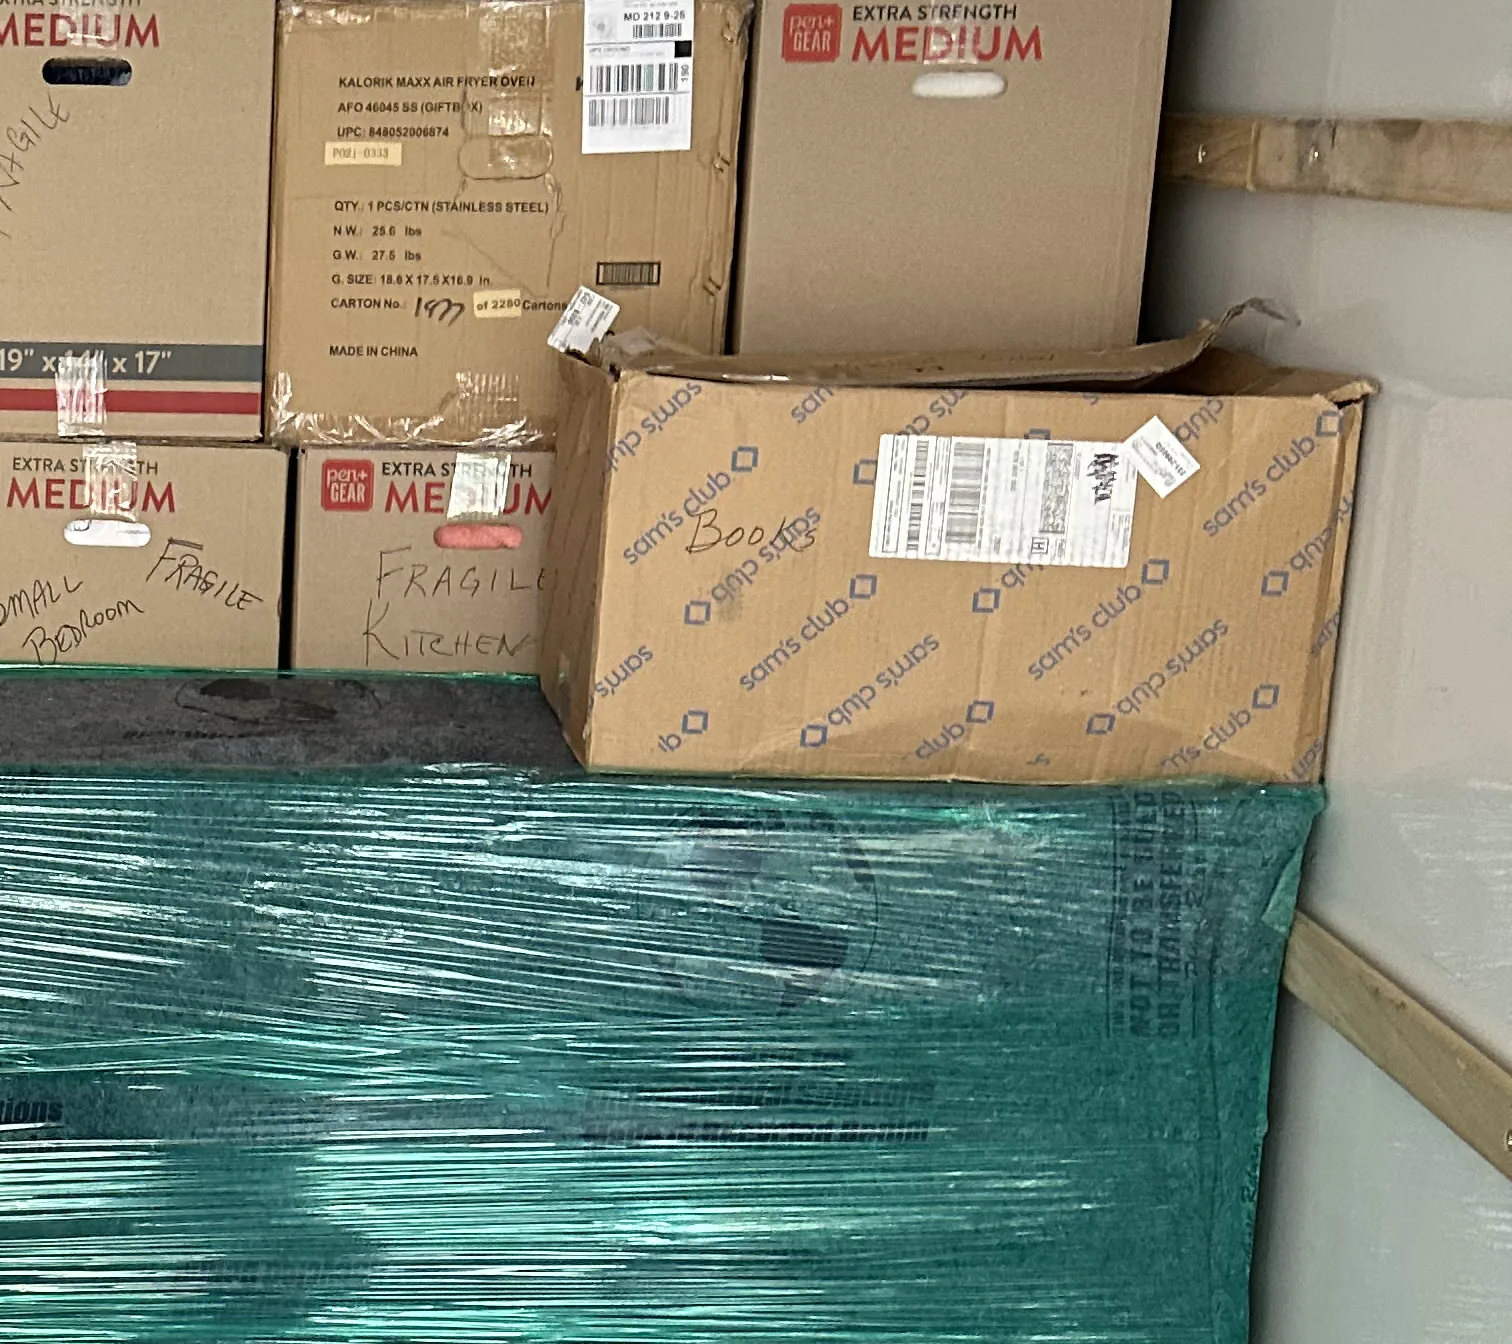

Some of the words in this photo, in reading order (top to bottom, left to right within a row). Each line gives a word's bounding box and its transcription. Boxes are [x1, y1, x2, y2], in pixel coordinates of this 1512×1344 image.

[624, 12, 640, 21] MD
[643, 11, 660, 20] 212
[853, 5, 911, 21] EXTRA
[918, 4, 1017, 21] STRENGTH
[793, 32, 831, 52] GEAR
[852, 25, 1042, 62] MEDIUM
[339, 77, 392, 88] KALORIK
[396, 77, 430, 88] MAXX
[433, 77, 454, 87] AIR
[457, 77, 498, 88] FRYER
[500, 76, 536, 87] OVEN
[338, 102, 363, 113] AFO
[402, 102, 418, 113] SS
[337, 127, 365, 137] UPC:
[368, 201, 374, 211] 1
[377, 201, 428, 212] PCS/CTN
[432, 201, 502, 214] (STAINLESS
[506, 202, 549, 215] STEEL)
[405, 226, 422, 236] lbs
[405, 250, 422, 260] lbs
[406, 275, 413, 285] X
[331, 298, 381, 308] CARTON
[477, 301, 488, 311] of
[41, 356, 57, 372] x
[112, 357, 128, 373] x
[135, 350, 172, 375] 17"
[330, 346, 363, 357] MADE
[366, 346, 378, 356] IN
[381, 346, 418, 357] CHINA
[12, 457, 65, 472] EXTRA
[382, 462, 436, 477] EXTRA
[441, 463, 532, 478] STRENTH
[7, 477, 175, 513] MEDIUM
[330, 484, 365, 503] GEAR
[385, 481, 552, 516] MEUM
[1203, 480, 1267, 538] sam's
[1267, 435, 1317, 483] club
[624, 510, 684, 565] sam's
[684, 471, 732, 518] club
[759, 507, 821, 563] sam's
[147, 538, 263, 611] FRAGILE
[711, 559, 758, 603] club
[363, 598, 530, 666] KITCHEN
[740, 637, 801, 692] sam's
[801, 597, 849, 641] club
[1028, 624, 1092, 681] sam's
[1092, 584, 1141, 629] club
[1165, 618, 1228, 677] sam's
[595, 645, 653, 698] sam's
[876, 634, 940, 689] sam's
[828, 684, 877, 726] club
[1115, 671, 1166, 716] club
[915, 722, 965, 760] club
[1203, 707, 1251, 751] club
